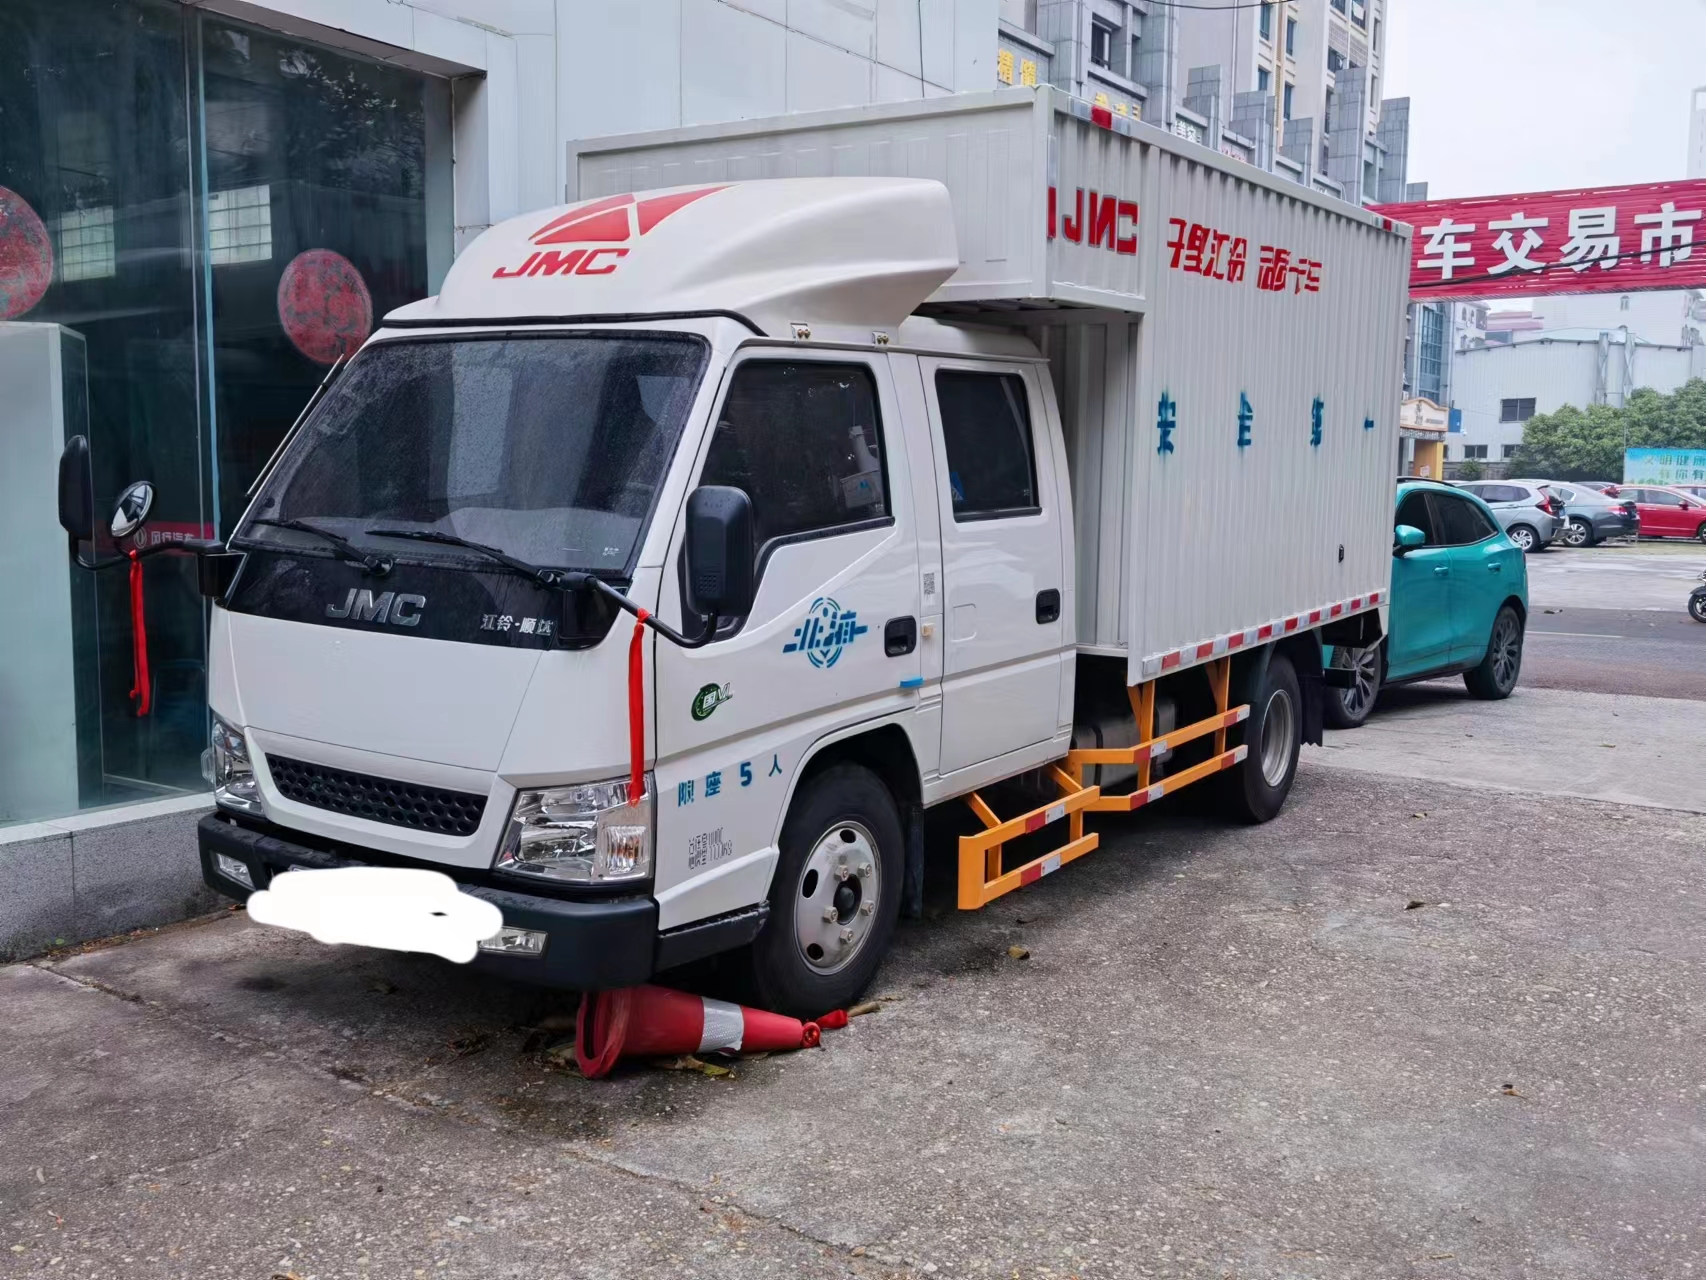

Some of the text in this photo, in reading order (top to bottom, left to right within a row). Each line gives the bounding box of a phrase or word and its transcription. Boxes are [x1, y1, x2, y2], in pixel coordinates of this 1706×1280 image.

[1417, 202, 1702, 279] 车交易市
[493, 248, 631, 279] JMC
[326, 588, 426, 627] JMC
